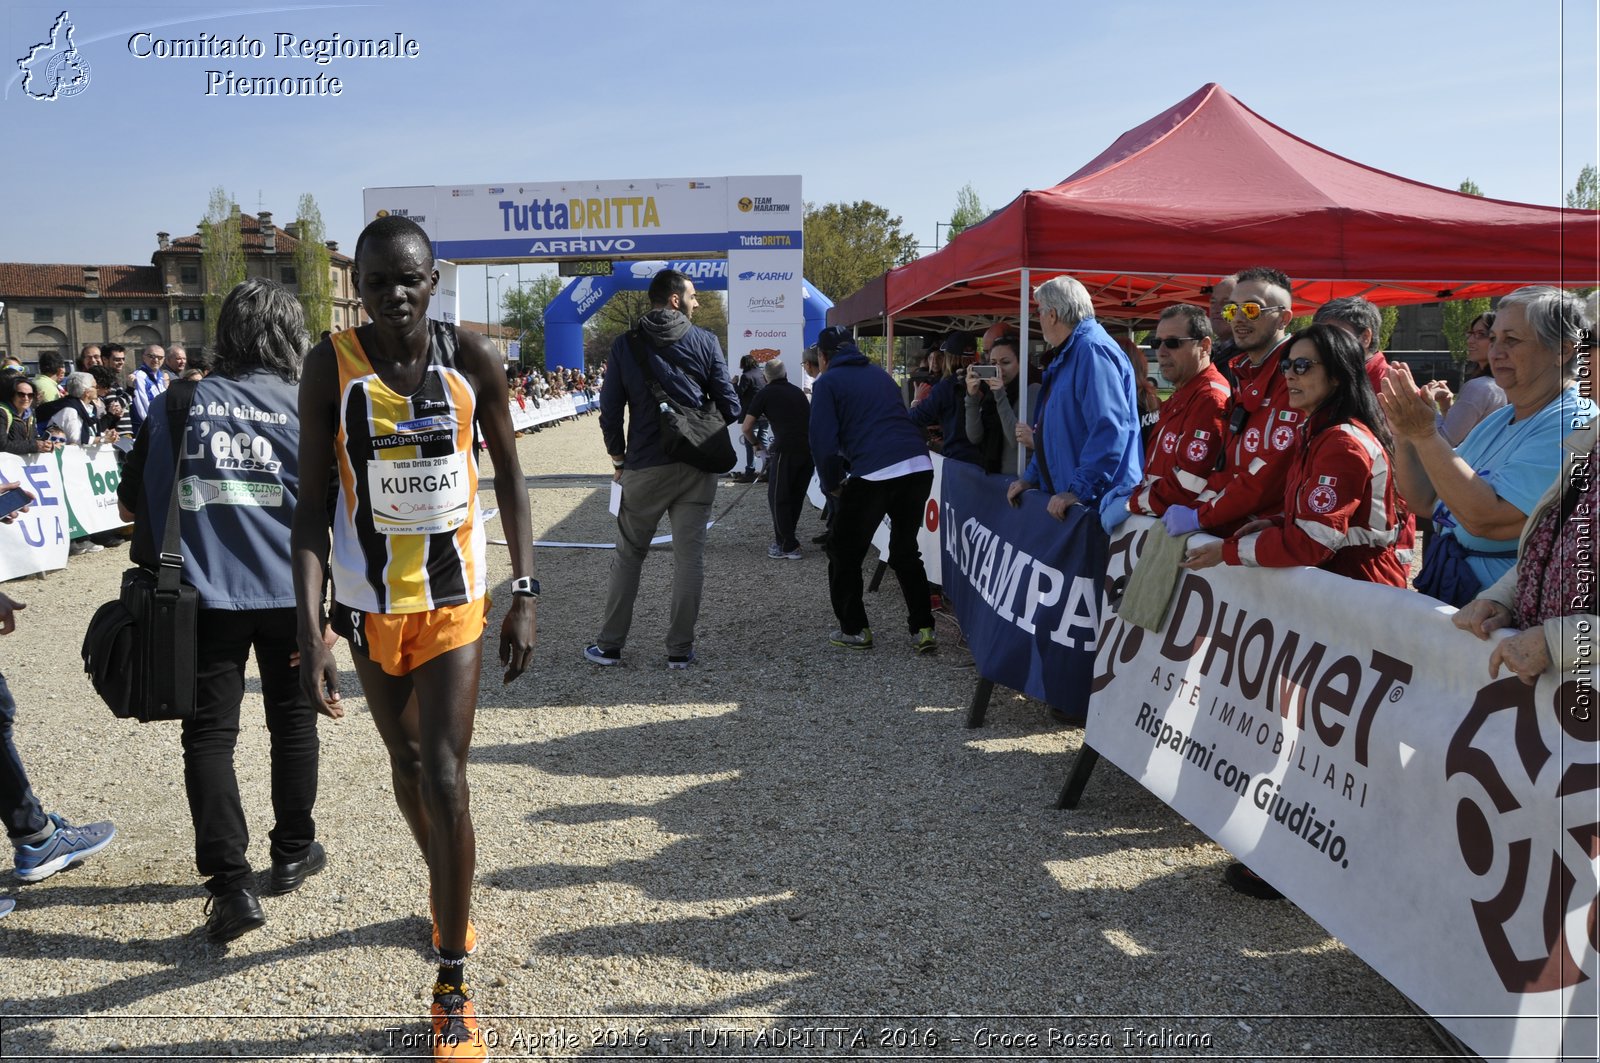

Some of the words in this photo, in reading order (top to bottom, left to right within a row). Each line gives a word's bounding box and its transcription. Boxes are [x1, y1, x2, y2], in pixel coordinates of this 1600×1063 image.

[753, 197, 772, 205] TEAM
[753, 204, 790, 212] MARATHON
[499, 197, 661, 232] TuttaDRITTA
[529, 239, 636, 254] ARRIVO
[740, 235, 791, 246] TuttaDRITTA
[756, 272, 793, 280] KARHU
[576, 287, 603, 314] KARHU
[755, 330, 787, 338] foodora
[207, 401, 230, 417] del
[233, 405, 287, 425] chisone
[372, 434, 452, 447] run2gether.com
[219, 457, 278, 472] mese
[393, 461, 411, 469] Tutta
[412, 459, 432, 468] Dritta
[220, 482, 281, 494] BUSSOLINO
[381, 471, 458, 494] KURGAT
[960, 517, 1099, 651] STAMPA
[1150, 666, 1201, 706] ASTE
[1209, 697, 1368, 808] IMMOBILIARI
[1135, 702, 1217, 772] Risparmi
[1213, 758, 1250, 797] con
[1254, 778, 1349, 870] Giudizio.
